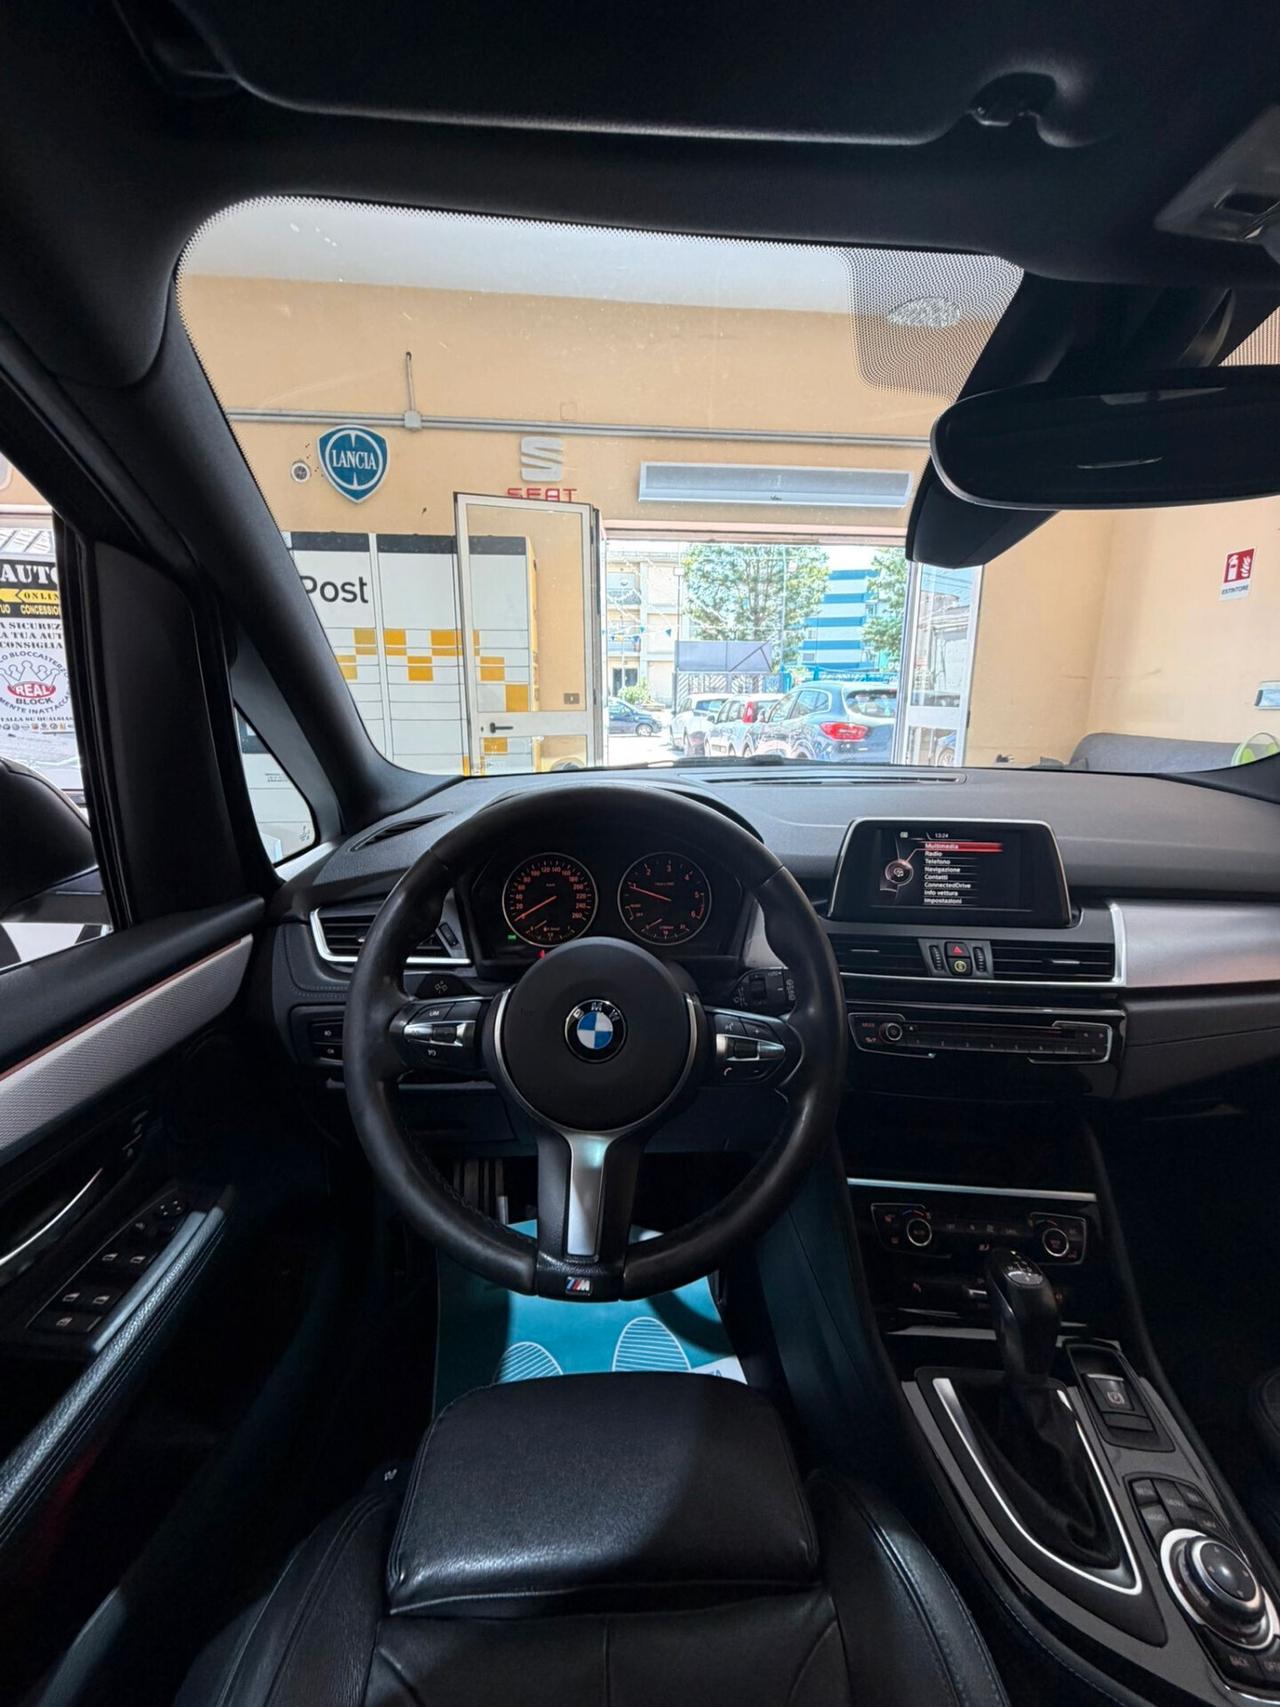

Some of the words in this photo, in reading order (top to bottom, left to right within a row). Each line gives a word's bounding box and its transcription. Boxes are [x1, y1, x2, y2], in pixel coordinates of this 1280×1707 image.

[332, 449, 377, 470] LANCIA
[506, 488, 578, 503] SEAT
[15, 684, 51, 698] REAL
[15, 698, 54, 706] BLOCK
[572, 1001, 621, 1022] BMW
